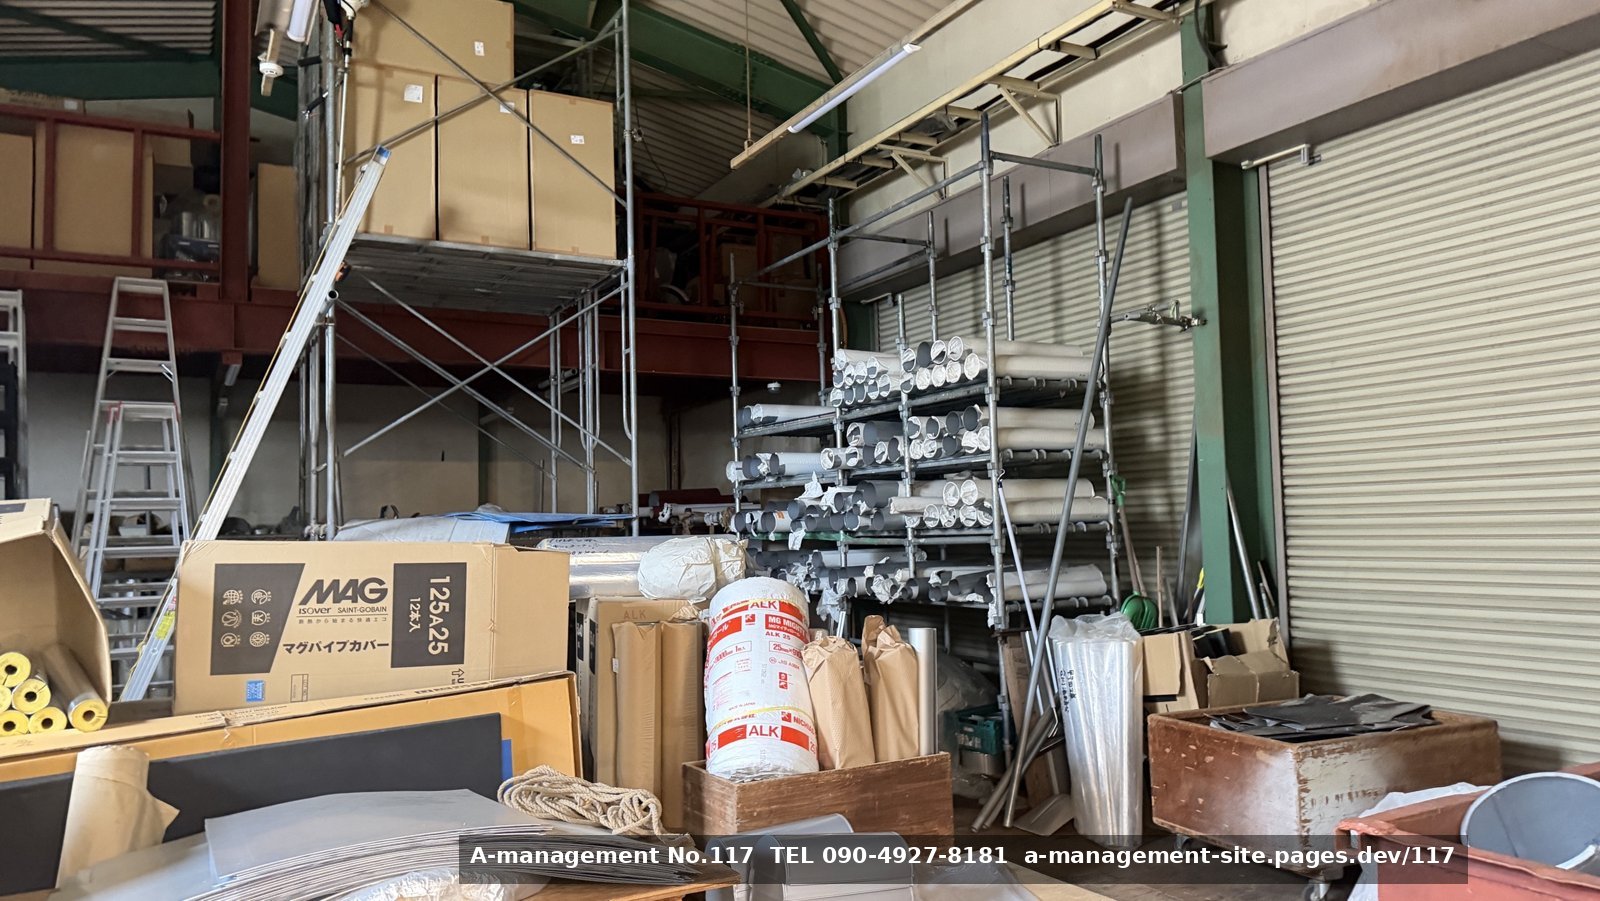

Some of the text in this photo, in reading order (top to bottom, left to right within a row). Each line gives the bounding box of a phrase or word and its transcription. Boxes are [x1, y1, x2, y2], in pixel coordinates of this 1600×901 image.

[298, 577, 388, 605] MAG
[750, 600, 778, 610] ALK
[409, 597, 421, 633] 12本入
[428, 575, 450, 655] 125A25
[623, 609, 646, 620] ALK
[282, 640, 389, 654] マグパイプカバー
[749, 725, 779, 738] ALK
